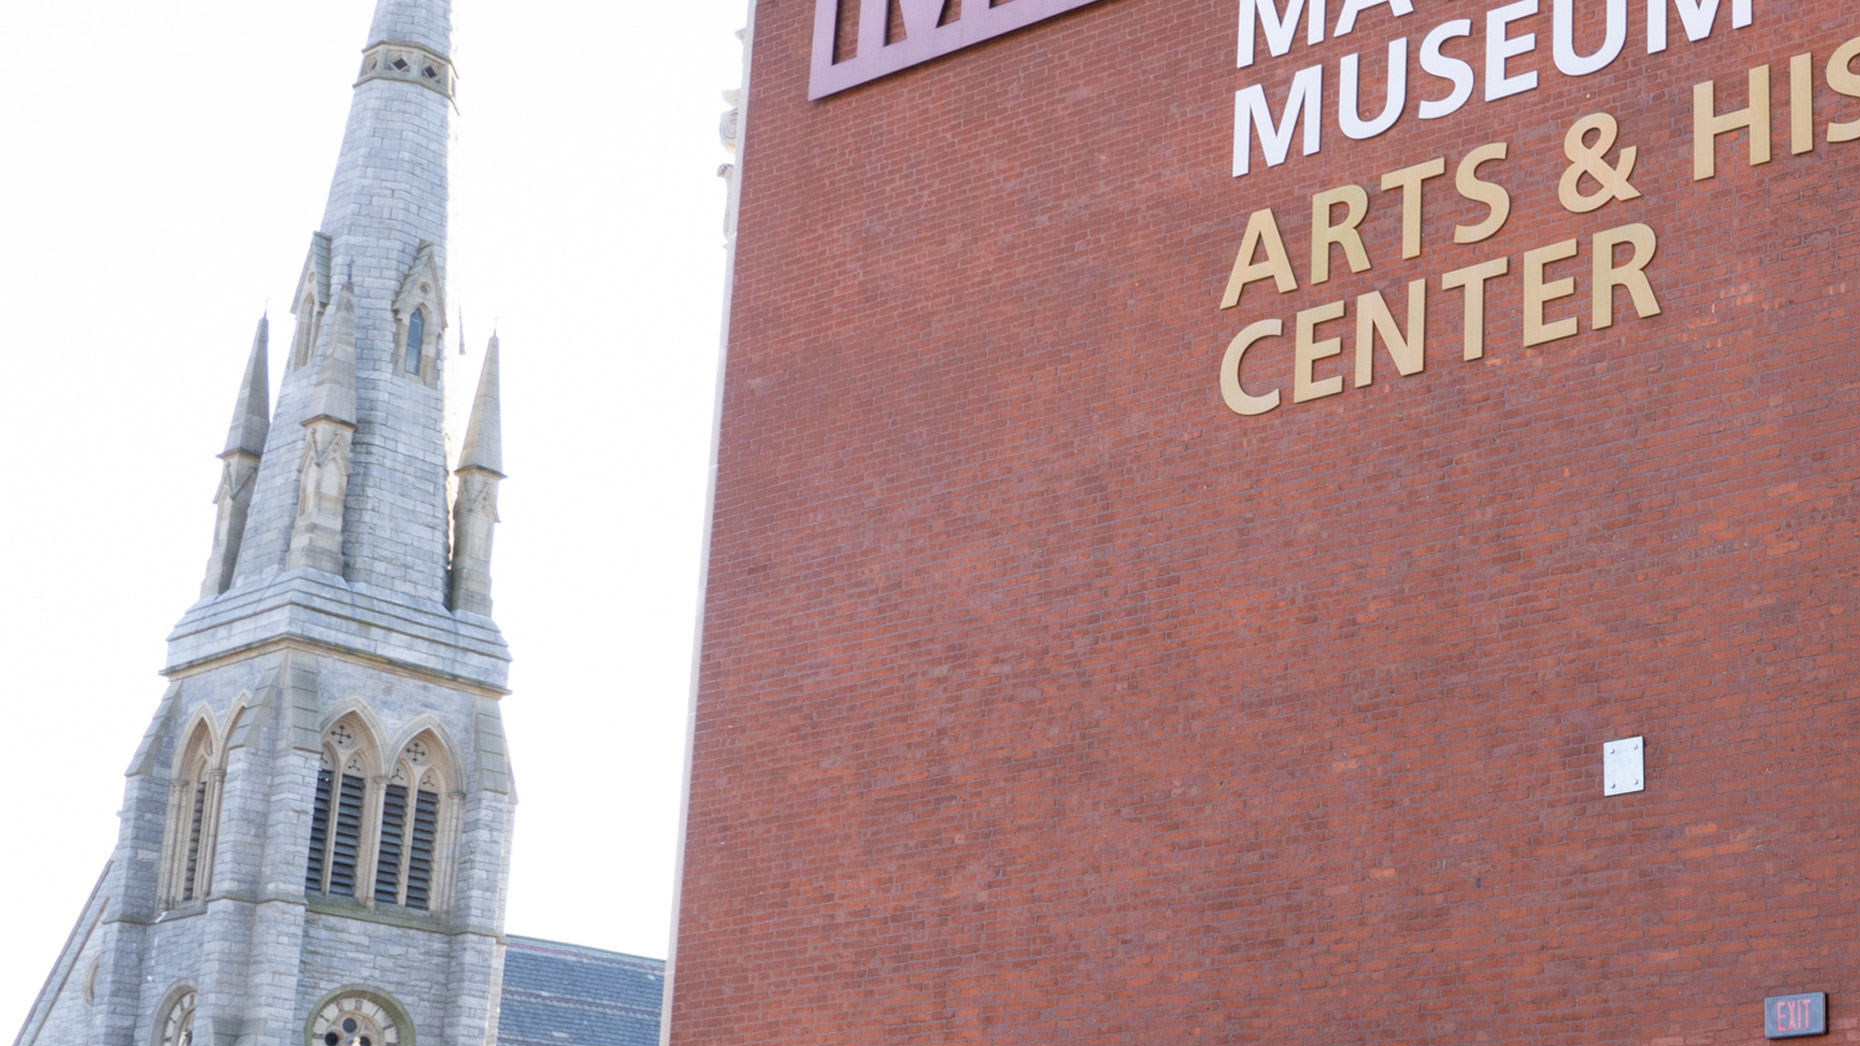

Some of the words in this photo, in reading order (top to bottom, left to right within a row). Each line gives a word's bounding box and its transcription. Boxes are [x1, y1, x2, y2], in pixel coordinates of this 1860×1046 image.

[1219, 142, 1510, 309] ARTS
[1557, 111, 1643, 213] &
[1219, 222, 1661, 416] CENTER
[1776, 999, 1811, 1031] EXIT
